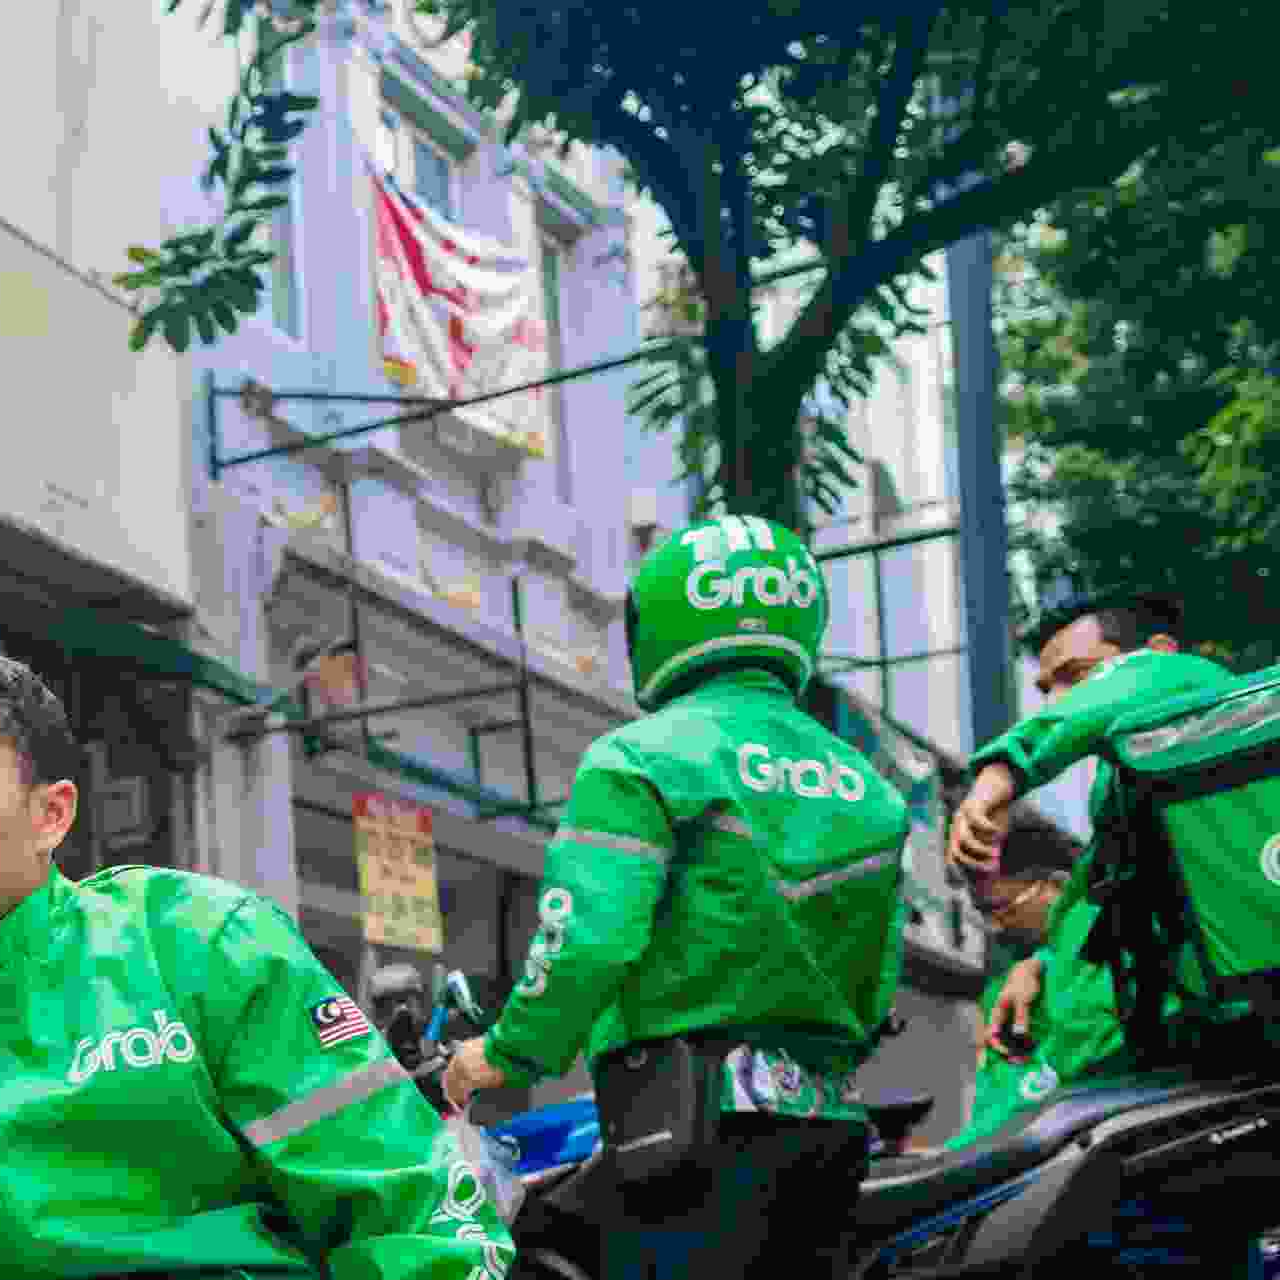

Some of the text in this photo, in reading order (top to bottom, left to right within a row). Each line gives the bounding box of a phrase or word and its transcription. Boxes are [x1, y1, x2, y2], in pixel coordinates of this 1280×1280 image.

[686, 556, 817, 609] Grab
[738, 743, 865, 801] Grab
[65, 1008, 195, 1085] Grab
